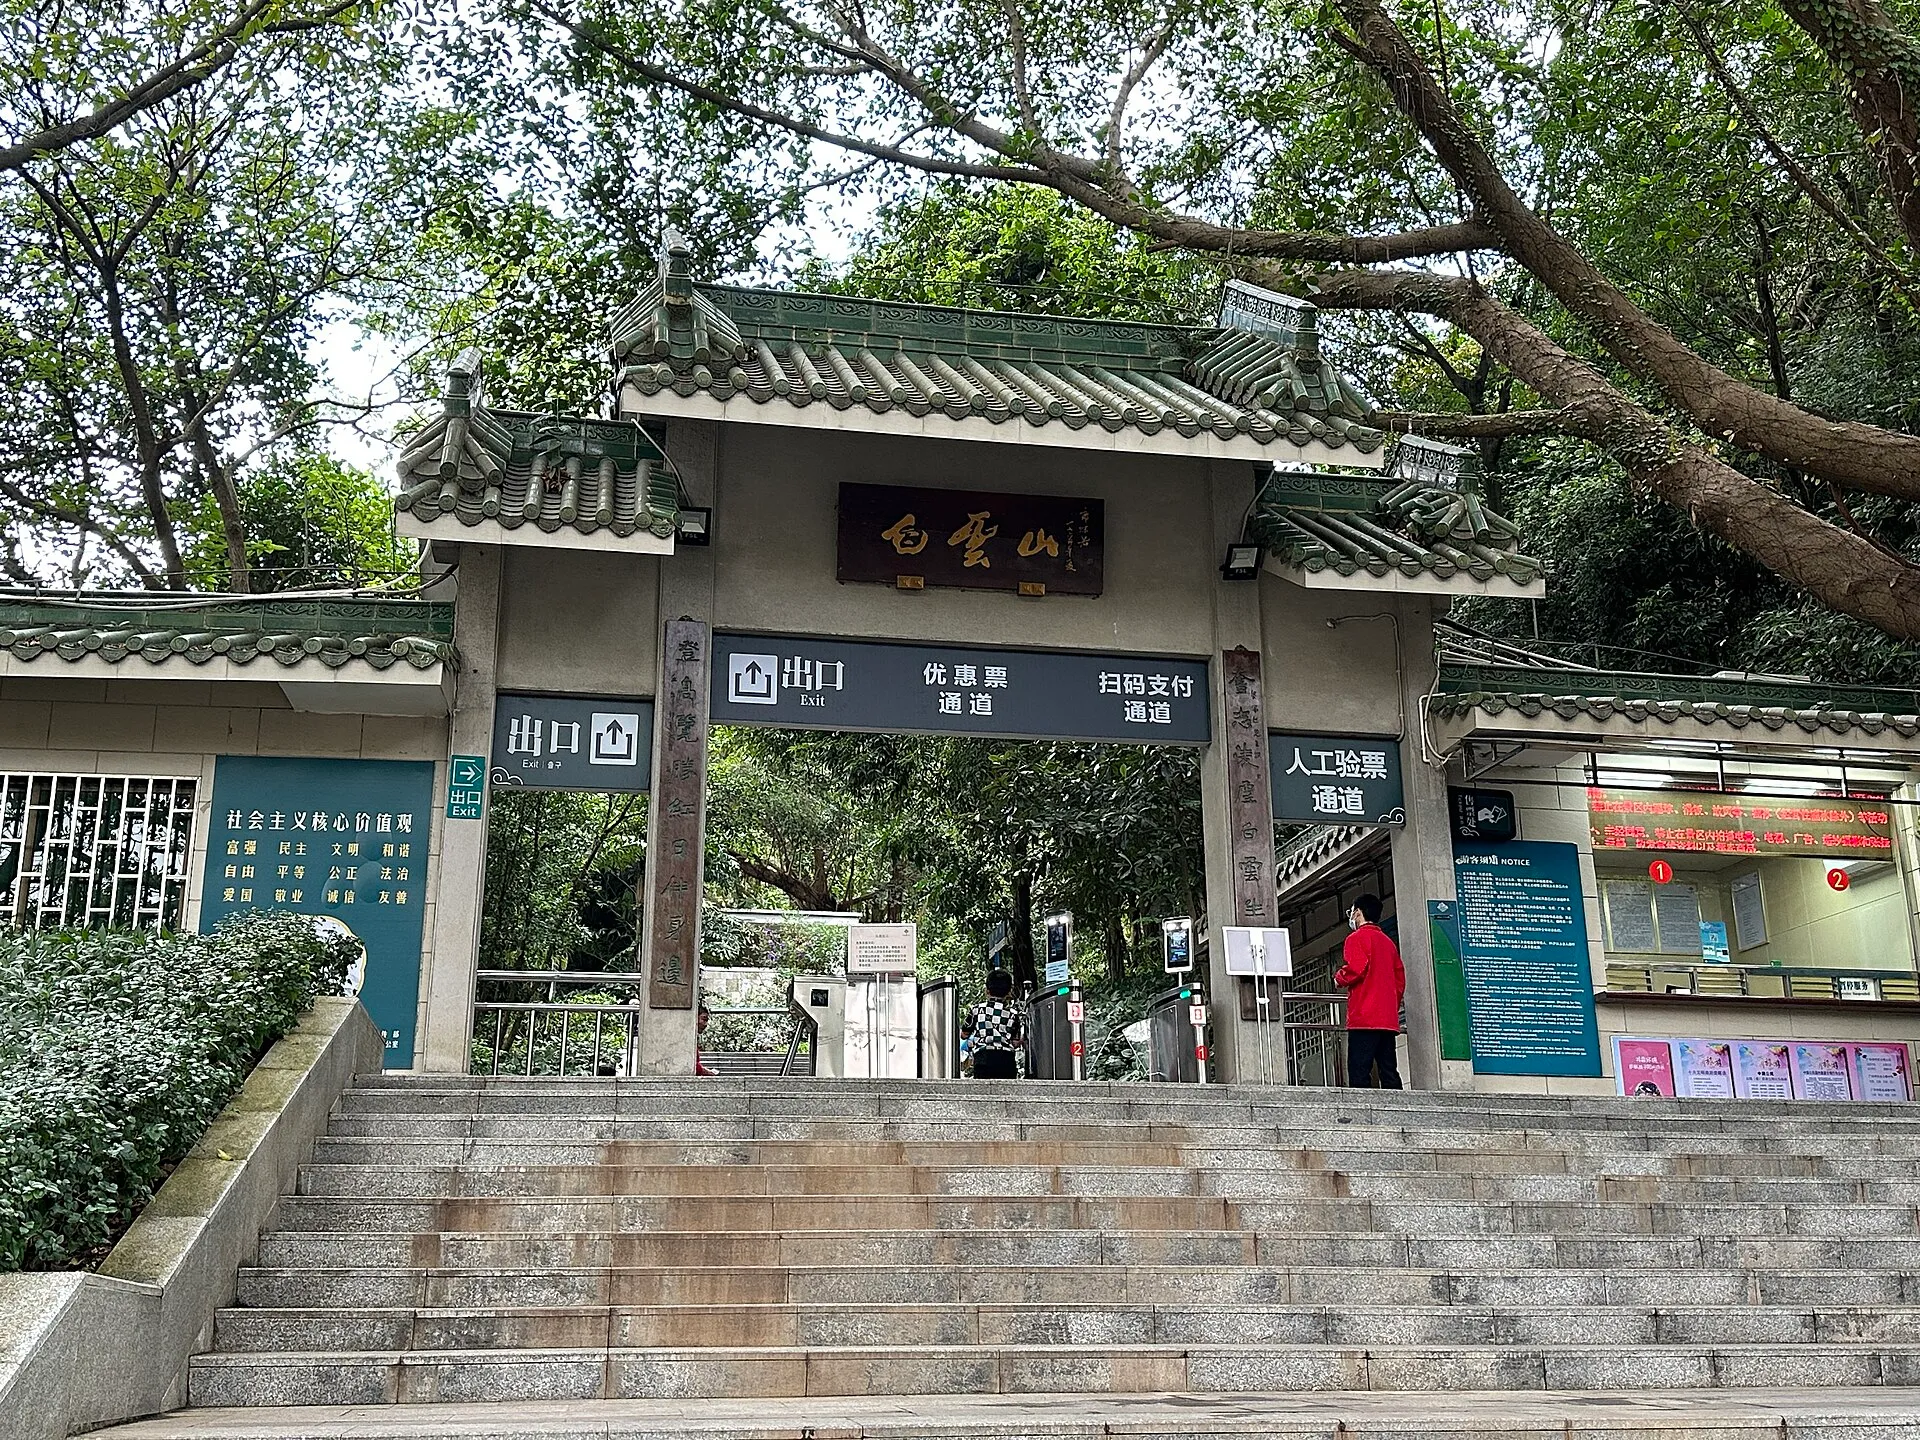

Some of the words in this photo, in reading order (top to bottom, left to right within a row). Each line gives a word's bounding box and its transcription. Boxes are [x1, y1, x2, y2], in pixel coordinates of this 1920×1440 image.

[881, 511, 1060, 568] 白雲山
[781, 655, 846, 692] 出口
[923, 662, 1009, 689] 优惠票
[1099, 671, 1194, 699] 扫码支付
[800, 694, 826, 707] Exit
[938, 691, 994, 716] 通道
[1123, 700, 1173, 725] 通道
[507, 714, 582, 757] 出口
[522, 759, 539, 769] Exit
[1285, 747, 1388, 780] 人工验票
[450, 790, 482, 805] 出口
[1311, 784, 1365, 816] 通道
[226, 809, 414, 834] 社会主义核心价值观
[452, 805, 478, 817] Exit
[226, 839, 258, 857] 富强
[278, 840, 308, 857] 民主
[331, 841, 360, 857] 文明
[382, 842, 411, 859] 和谐
[224, 863, 255, 880] 自由
[276, 864, 306, 881] 平等
[329, 865, 358, 881] 公正
[380, 866, 409, 882] 法治
[1501, 857, 1531, 866] NOTICE
[1834, 873, 1844, 888] 2
[223, 887, 254, 903] 爱国
[274, 888, 304, 904] 敬业
[327, 888, 356, 905] 诚信
[378, 889, 408, 905] 友善
[1073, 1043, 1082, 1055] 2
